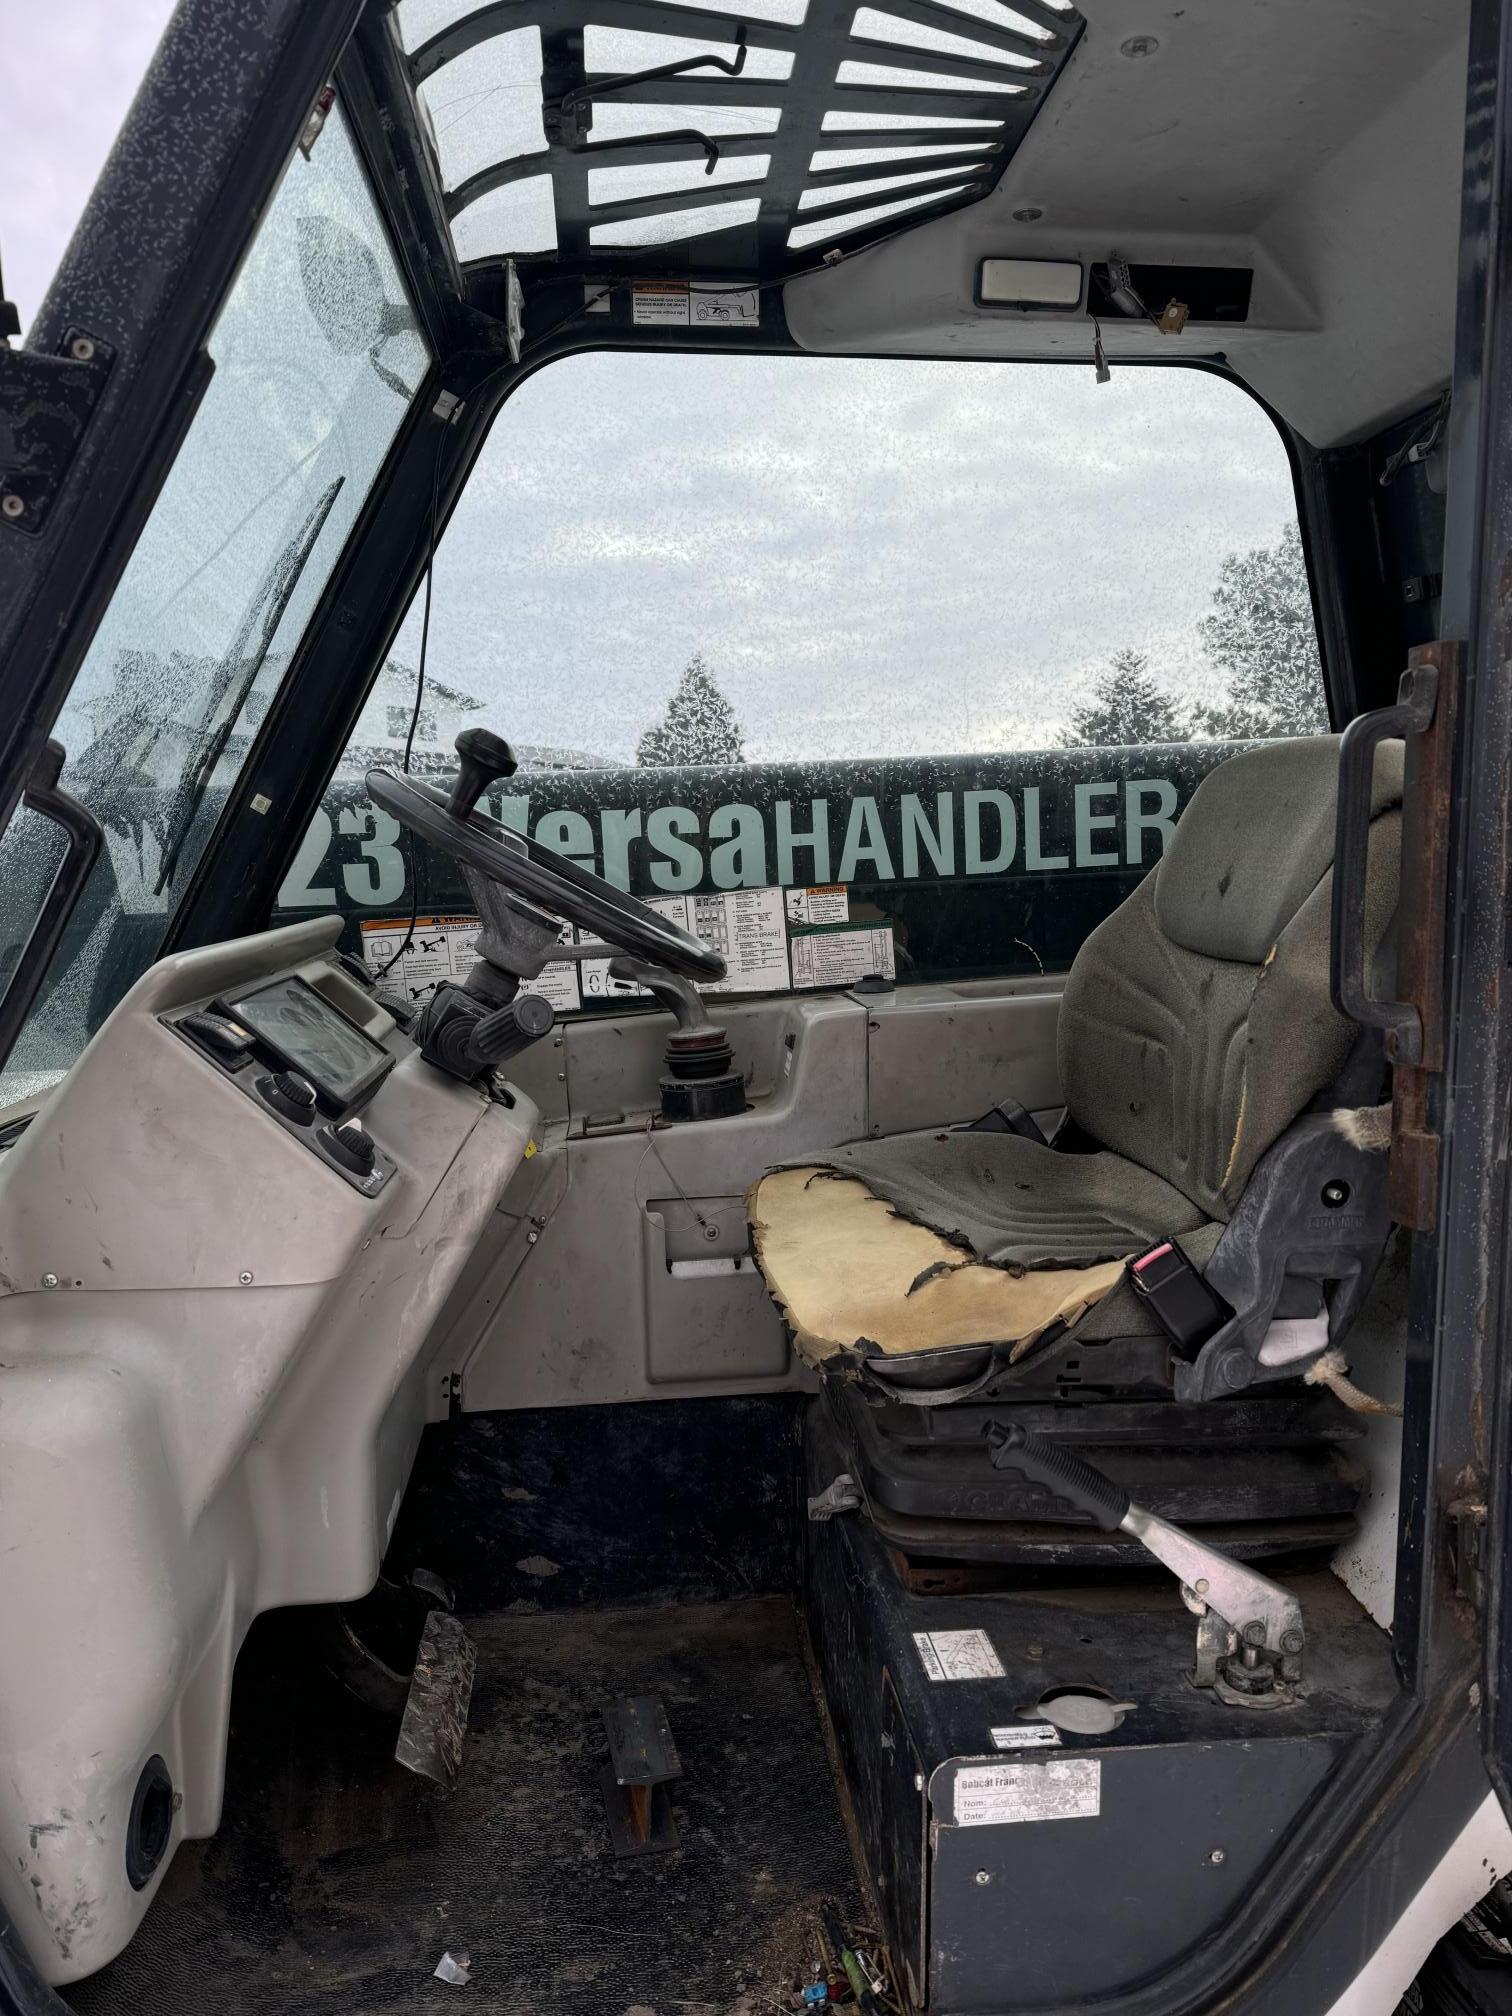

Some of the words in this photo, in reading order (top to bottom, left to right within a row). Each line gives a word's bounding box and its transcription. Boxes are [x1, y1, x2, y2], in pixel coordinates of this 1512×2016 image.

[759, 930, 779, 938] BRAKE
[961, 1777, 994, 1790] Bobcat
[963, 1811, 987, 1822] Date:
